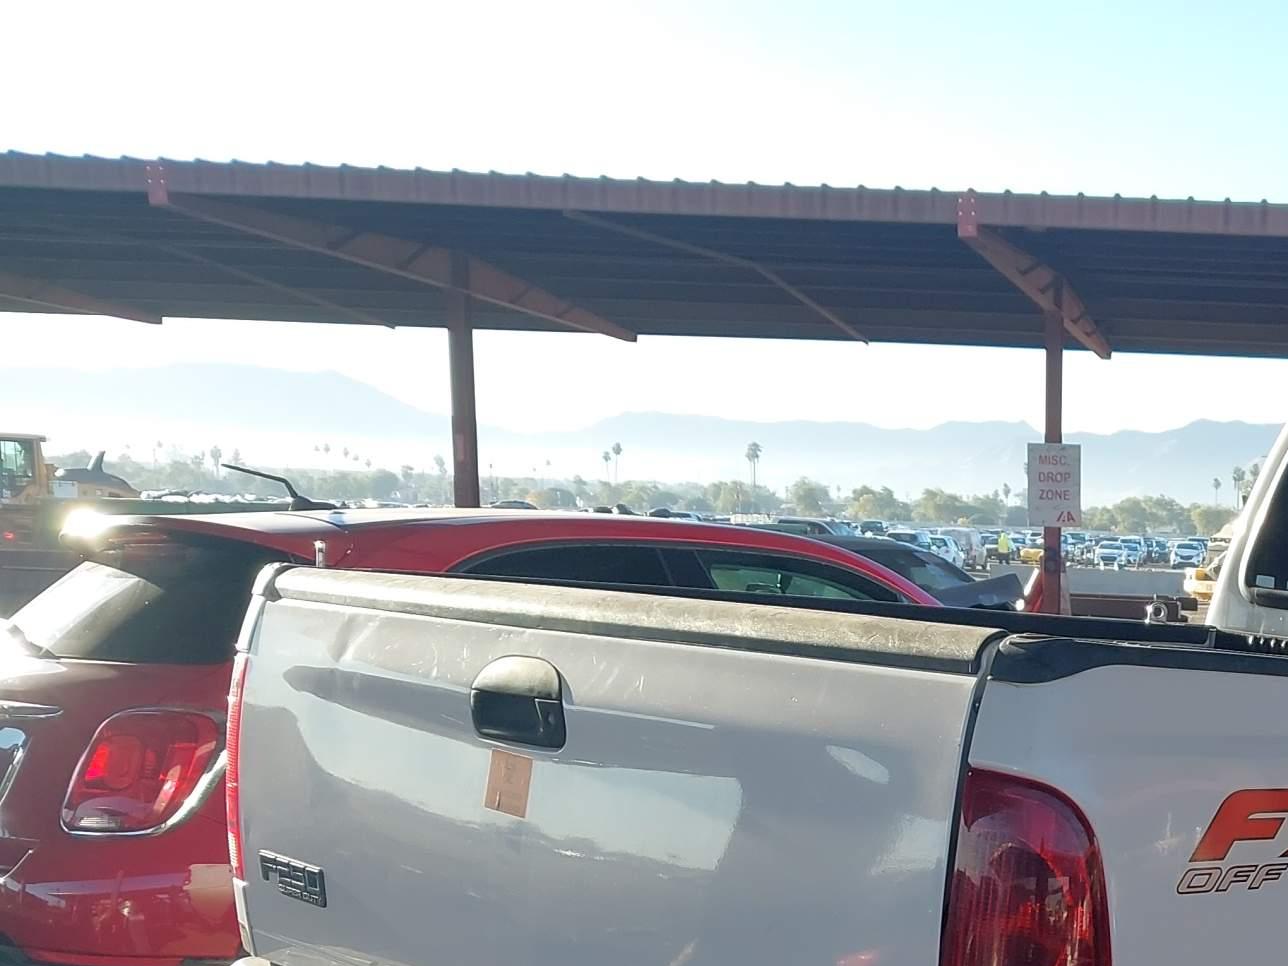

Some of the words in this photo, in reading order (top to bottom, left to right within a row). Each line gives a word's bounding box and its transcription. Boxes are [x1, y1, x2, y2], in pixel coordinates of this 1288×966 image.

[1038, 455, 1070, 466] MISC.
[1038, 472, 1071, 483] DROP
[1039, 489, 1071, 501] ZONE
[258, 850, 321, 892] F250
